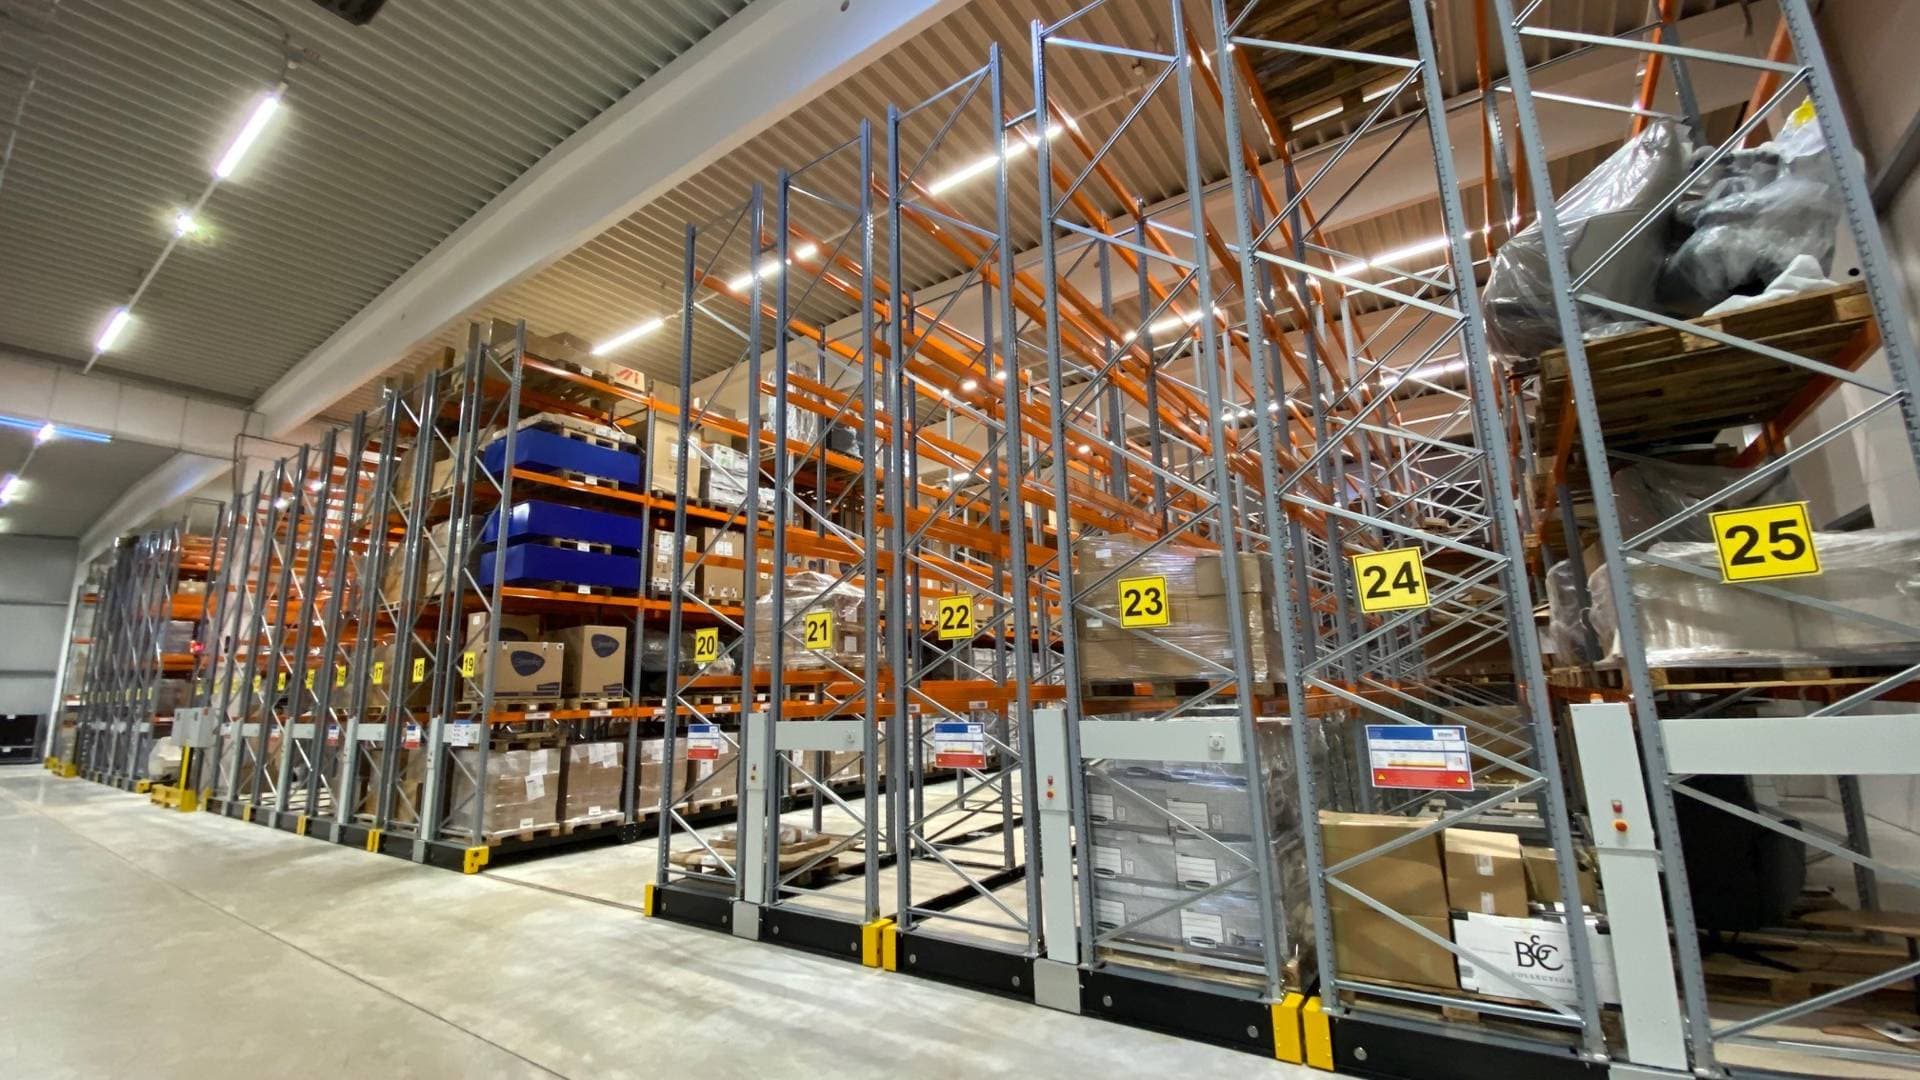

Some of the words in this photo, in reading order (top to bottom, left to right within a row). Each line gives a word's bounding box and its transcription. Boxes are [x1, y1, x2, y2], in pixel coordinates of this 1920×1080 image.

[1724, 519, 1807, 566] 25
[1362, 560, 1421, 600] 24
[1123, 587, 1163, 617] 23
[941, 604, 970, 631] 22
[807, 620, 828, 642] 21
[697, 635, 715, 655] 20
[374, 667, 383, 680] 17
[415, 663, 424, 677] 18
[464, 656, 474, 672] 19
[1514, 935, 1564, 971] B&C
[1511, 972, 1573, 984] COLLECTION
